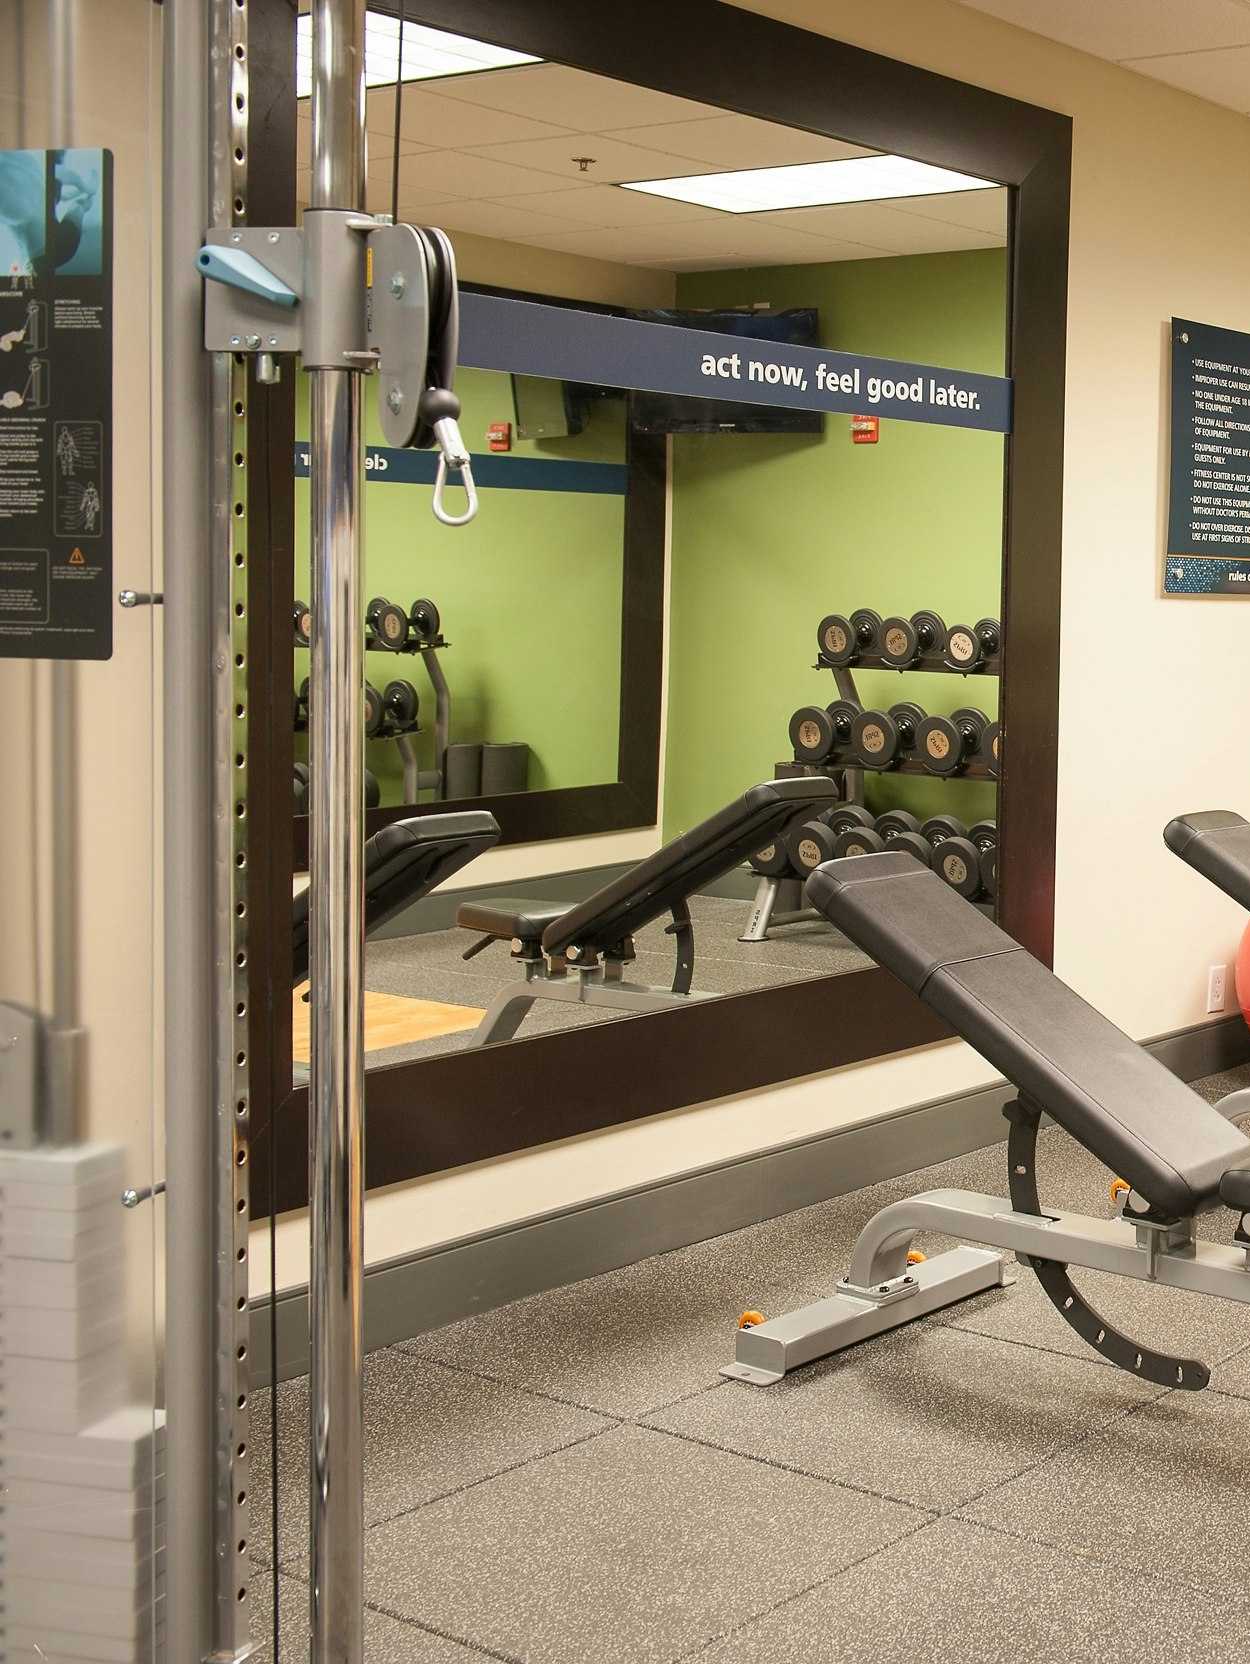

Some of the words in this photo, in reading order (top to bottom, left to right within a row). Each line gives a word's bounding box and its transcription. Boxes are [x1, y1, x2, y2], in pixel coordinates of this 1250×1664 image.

[1194, 358, 1204, 368] USE
[1204, 360, 1232, 373] EQUIPMENT
[1232, 366, 1239, 374] AT
[701, 353, 741, 379] act
[748, 360, 808, 391] now,
[816, 363, 860, 395] feel
[867, 377, 923, 404] good
[929, 379, 981, 410] later.
[1194, 374, 1219, 386] IMPROPER
[1219, 379, 1228, 388] USE
[1228, 380, 1238, 390] CAN
[1194, 390, 1203, 398] NO
[1203, 391, 1214, 401] ONE
[1214, 393, 1231, 403] UNDER
[1230, 396, 1241, 405] AGE
[1241, 398, 1248, 406] 18
[1194, 400, 1205, 410] THE
[1205, 402, 1234, 414] EQUIPMENT.
[1194, 416, 1215, 427] FOLLOW
[1215, 419, 1224, 428] ALL
[1224, 420, 1250, 432] DIRECTIONS
[1194, 427, 1202, 436] OF
[1202, 428, 1231, 440] EQUIPMENT.
[1194, 442, 1222, 454] EQUIPMENT
[1222, 446, 1232, 455] FOR
[1232, 447, 1242, 456] USE
[1242, 449, 1249, 457] BY
[1194, 453, 1212, 463] GUESTS
[1212, 455, 1226, 465] ONLY.
[1193, 469, 1212, 479] FITNESS
[1212, 471, 1231, 480] CENTER
[1230, 473, 1235, 481] IS
[1235, 474, 1247, 483] NOT
[1193, 480, 1202, 488] DO
[1201, 481, 1213, 489] NOT
[1213, 482, 1234, 492] EXERCISE
[1234, 485, 1250, 493] ALONE.
[1193, 495, 1202, 504] DO
[1201, 496, 1213, 505] NOT
[1212, 497, 1222, 506] USE
[1222, 498, 1233, 507] THIS
[1192, 506, 1216, 516] WITHOUT
[1215, 508, 1239, 517] DOCTOR'S
[1192, 521, 1200, 530] DO
[1200, 522, 1211, 530] NOT
[1211, 523, 1224, 532] OVER
[1191, 533, 1202, 541] USE
[1201, 533, 1209, 541] AT
[1208, 534, 1221, 542] FIRST
[1221, 535, 1235, 543] SIGNS
[1228, 570, 1247, 582] rules
